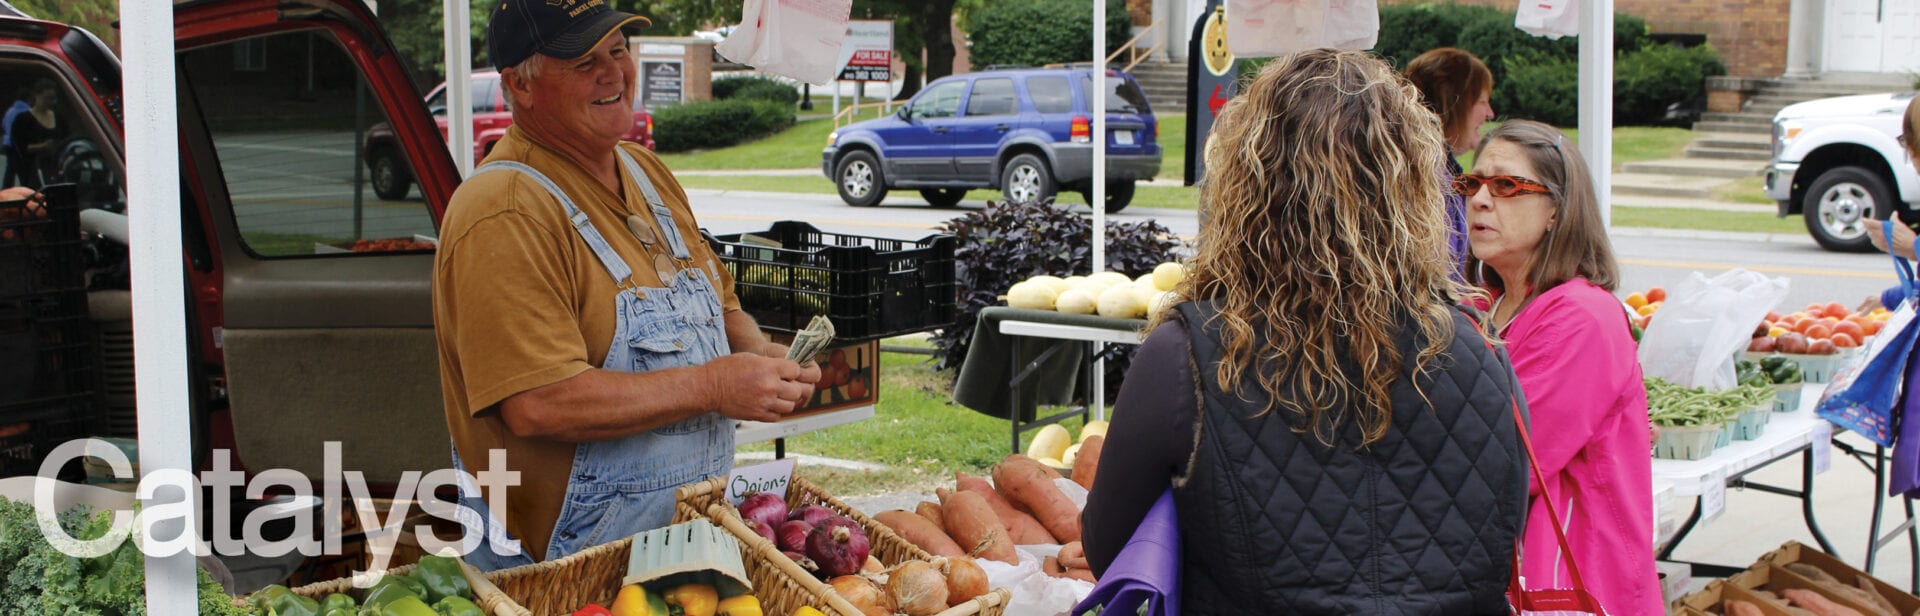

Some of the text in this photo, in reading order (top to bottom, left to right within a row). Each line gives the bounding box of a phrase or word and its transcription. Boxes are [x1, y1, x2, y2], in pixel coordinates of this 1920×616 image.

[856, 50, 889, 60] FOR SALE
[871, 71, 889, 80] 1000
[731, 474, 786, 498] Onions
